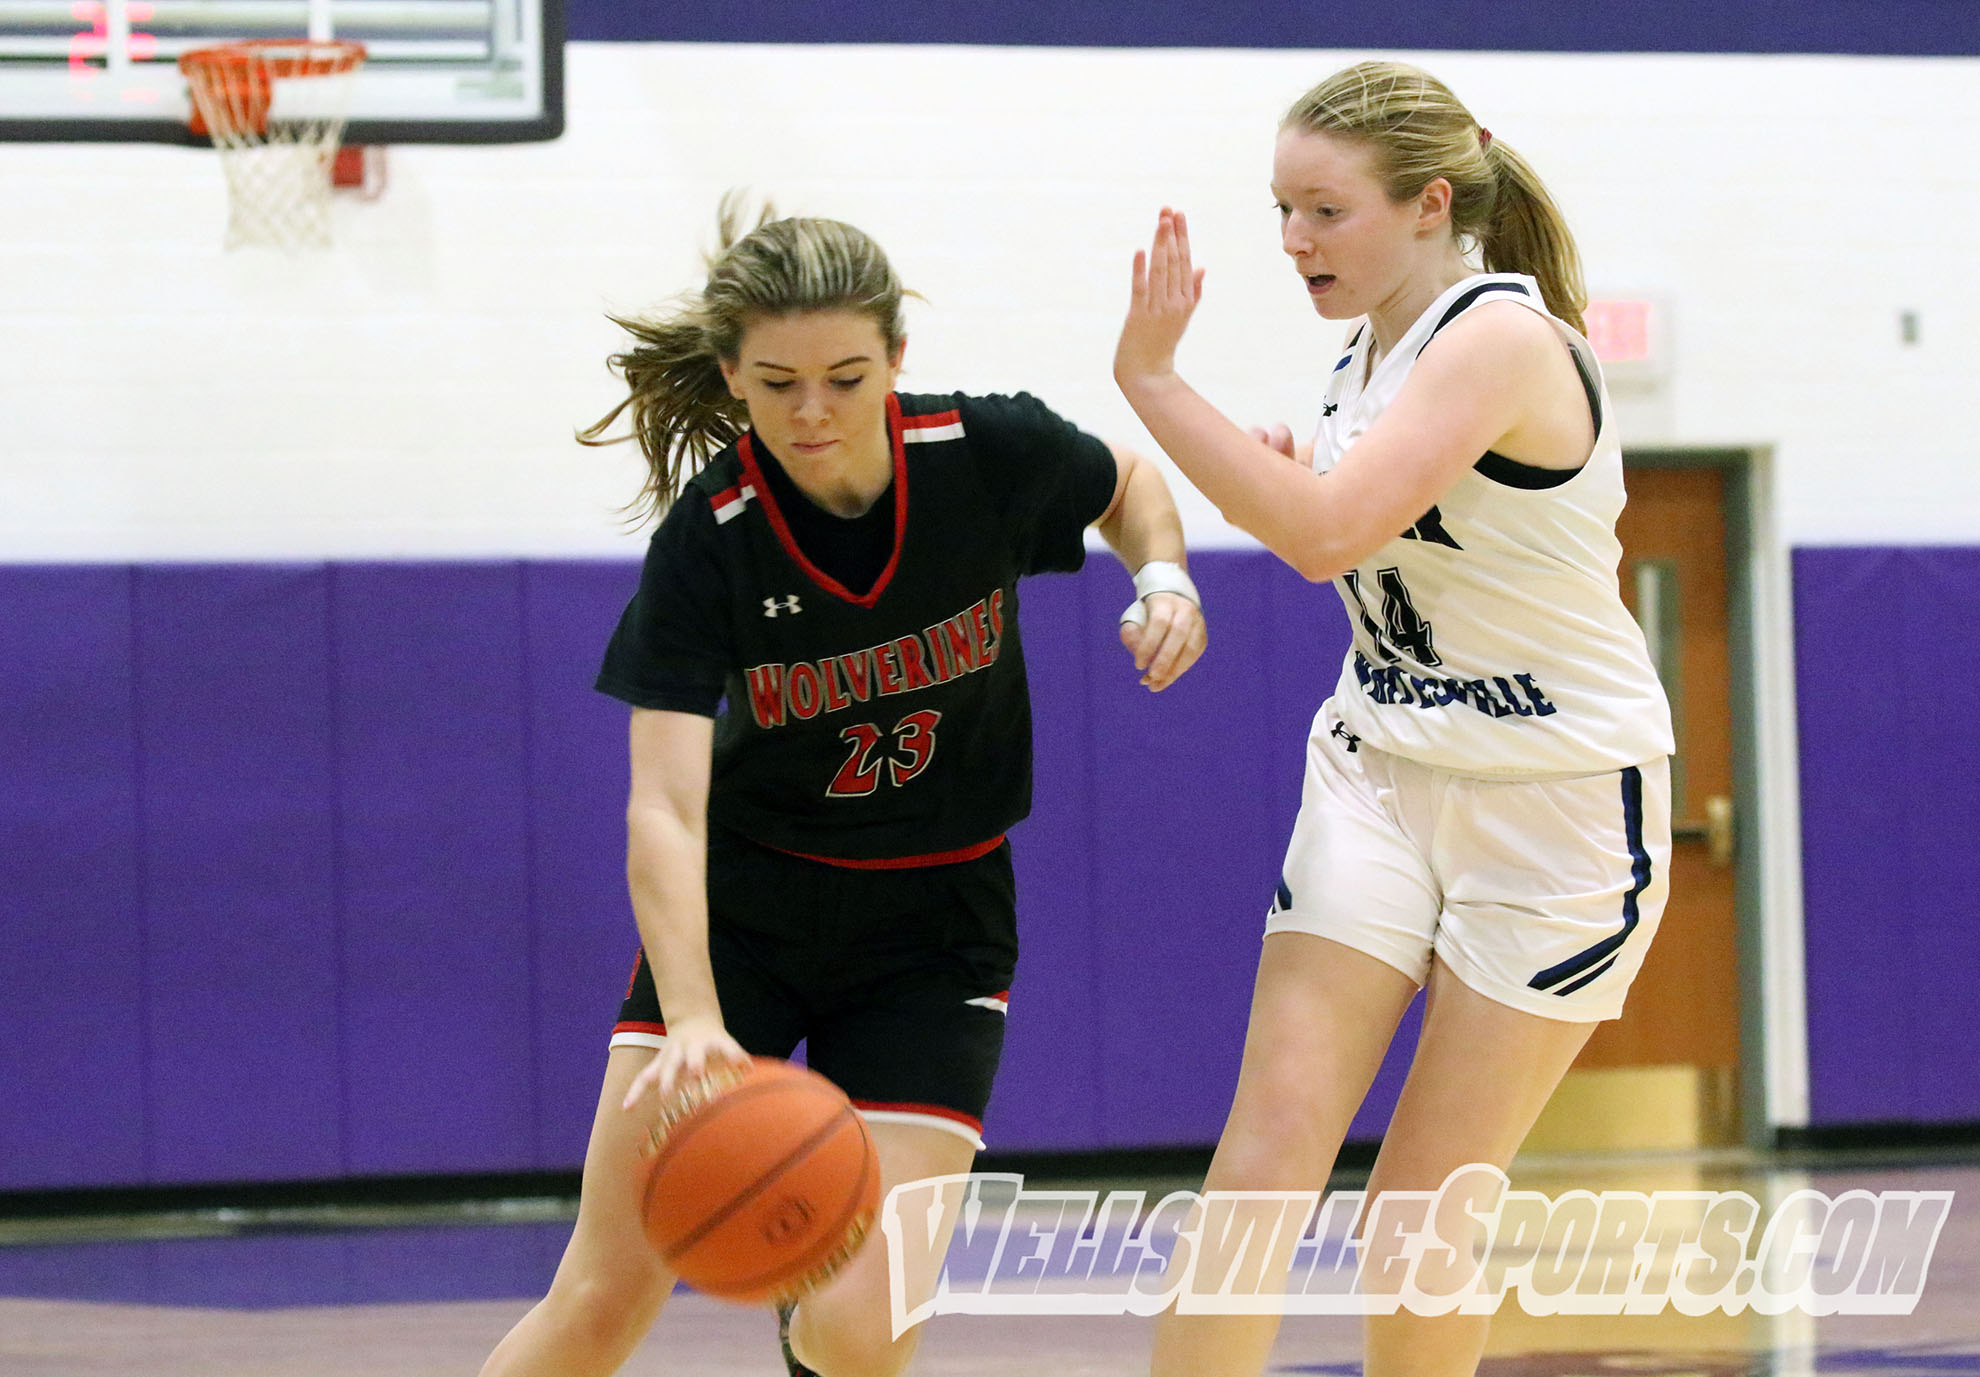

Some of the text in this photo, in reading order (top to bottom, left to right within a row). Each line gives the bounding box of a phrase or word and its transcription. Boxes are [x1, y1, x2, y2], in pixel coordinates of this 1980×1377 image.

[744, 588, 1004, 729] WOLVERINES
[1342, 566, 1443, 667] 14
[825, 709, 942, 798] 23
